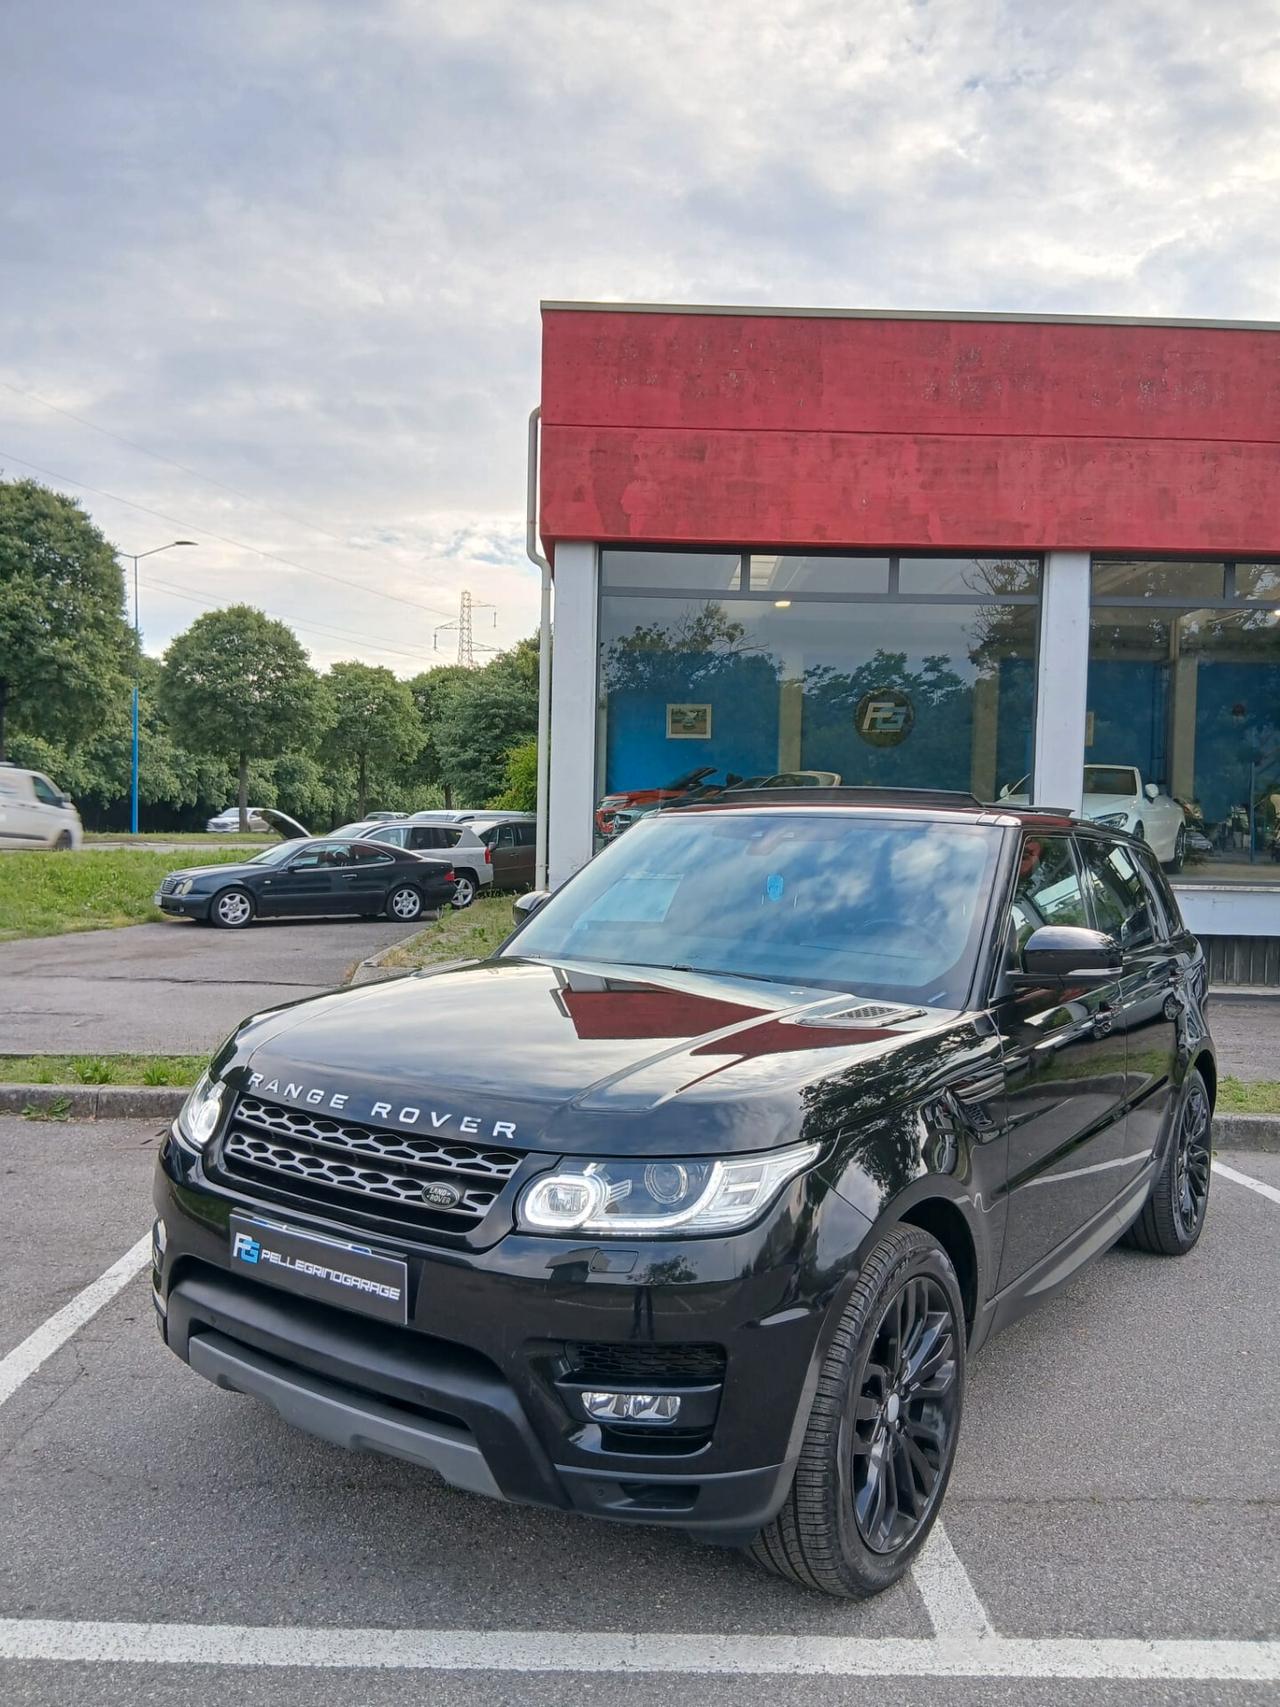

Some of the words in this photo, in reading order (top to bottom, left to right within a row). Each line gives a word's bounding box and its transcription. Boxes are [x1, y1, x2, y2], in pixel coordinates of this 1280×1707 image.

[247, 1072, 349, 1110] RANGE
[371, 1102, 516, 1139] ROVER
[430, 1187, 447, 1196] LAND
[430, 1194, 450, 1204] ROVER
[261, 1249, 401, 1301] PELLEGRINOGARAGE
